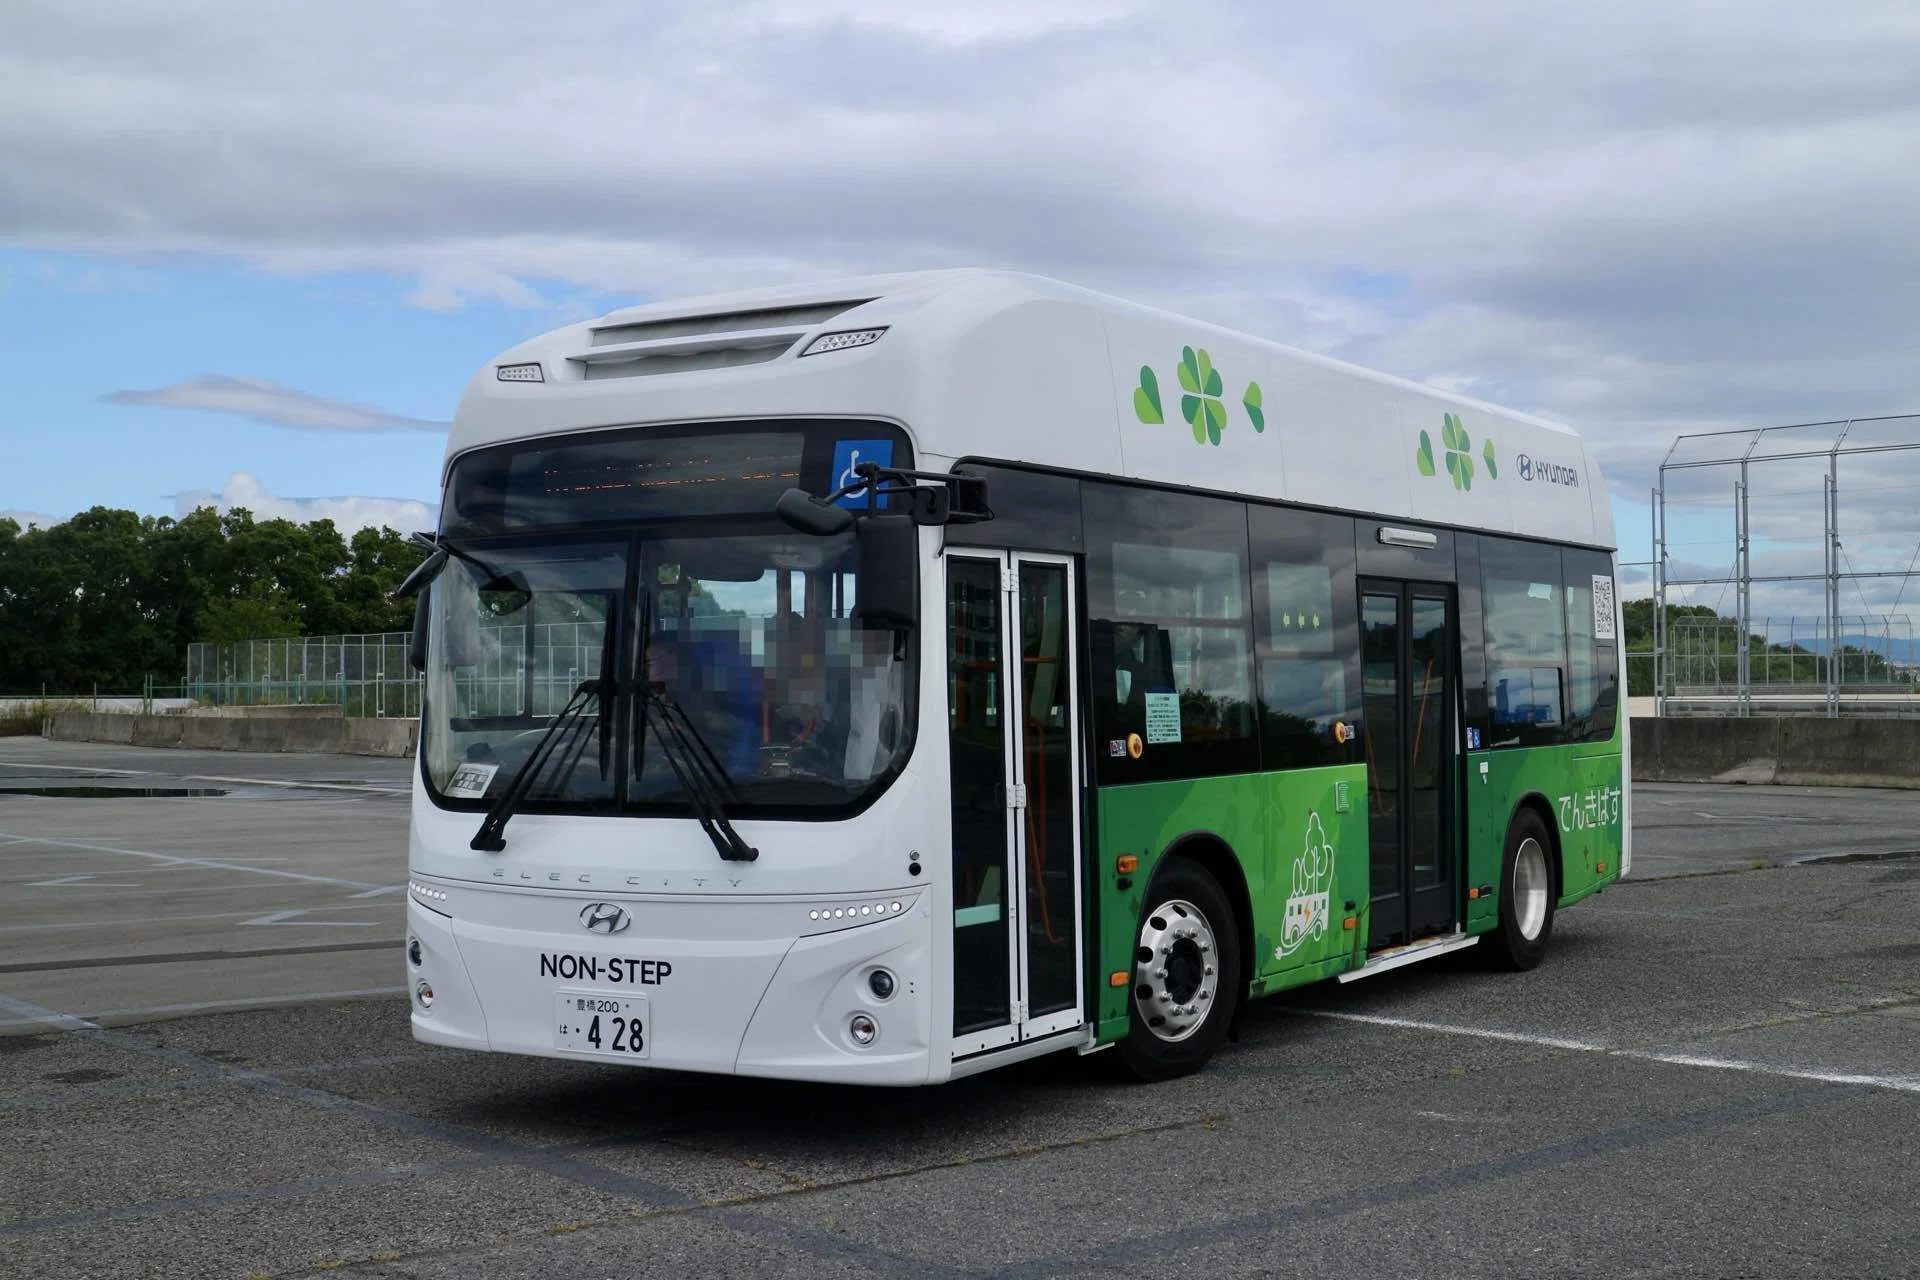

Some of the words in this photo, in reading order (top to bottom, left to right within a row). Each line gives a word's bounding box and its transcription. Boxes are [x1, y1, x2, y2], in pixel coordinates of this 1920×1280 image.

[1535, 460, 1579, 488] HYUNDAI
[1558, 786, 1621, 832] でんきばす
[493, 868, 591, 884] ELEC
[626, 875, 743, 888] CITY
[540, 953, 672, 985] NON-STEP
